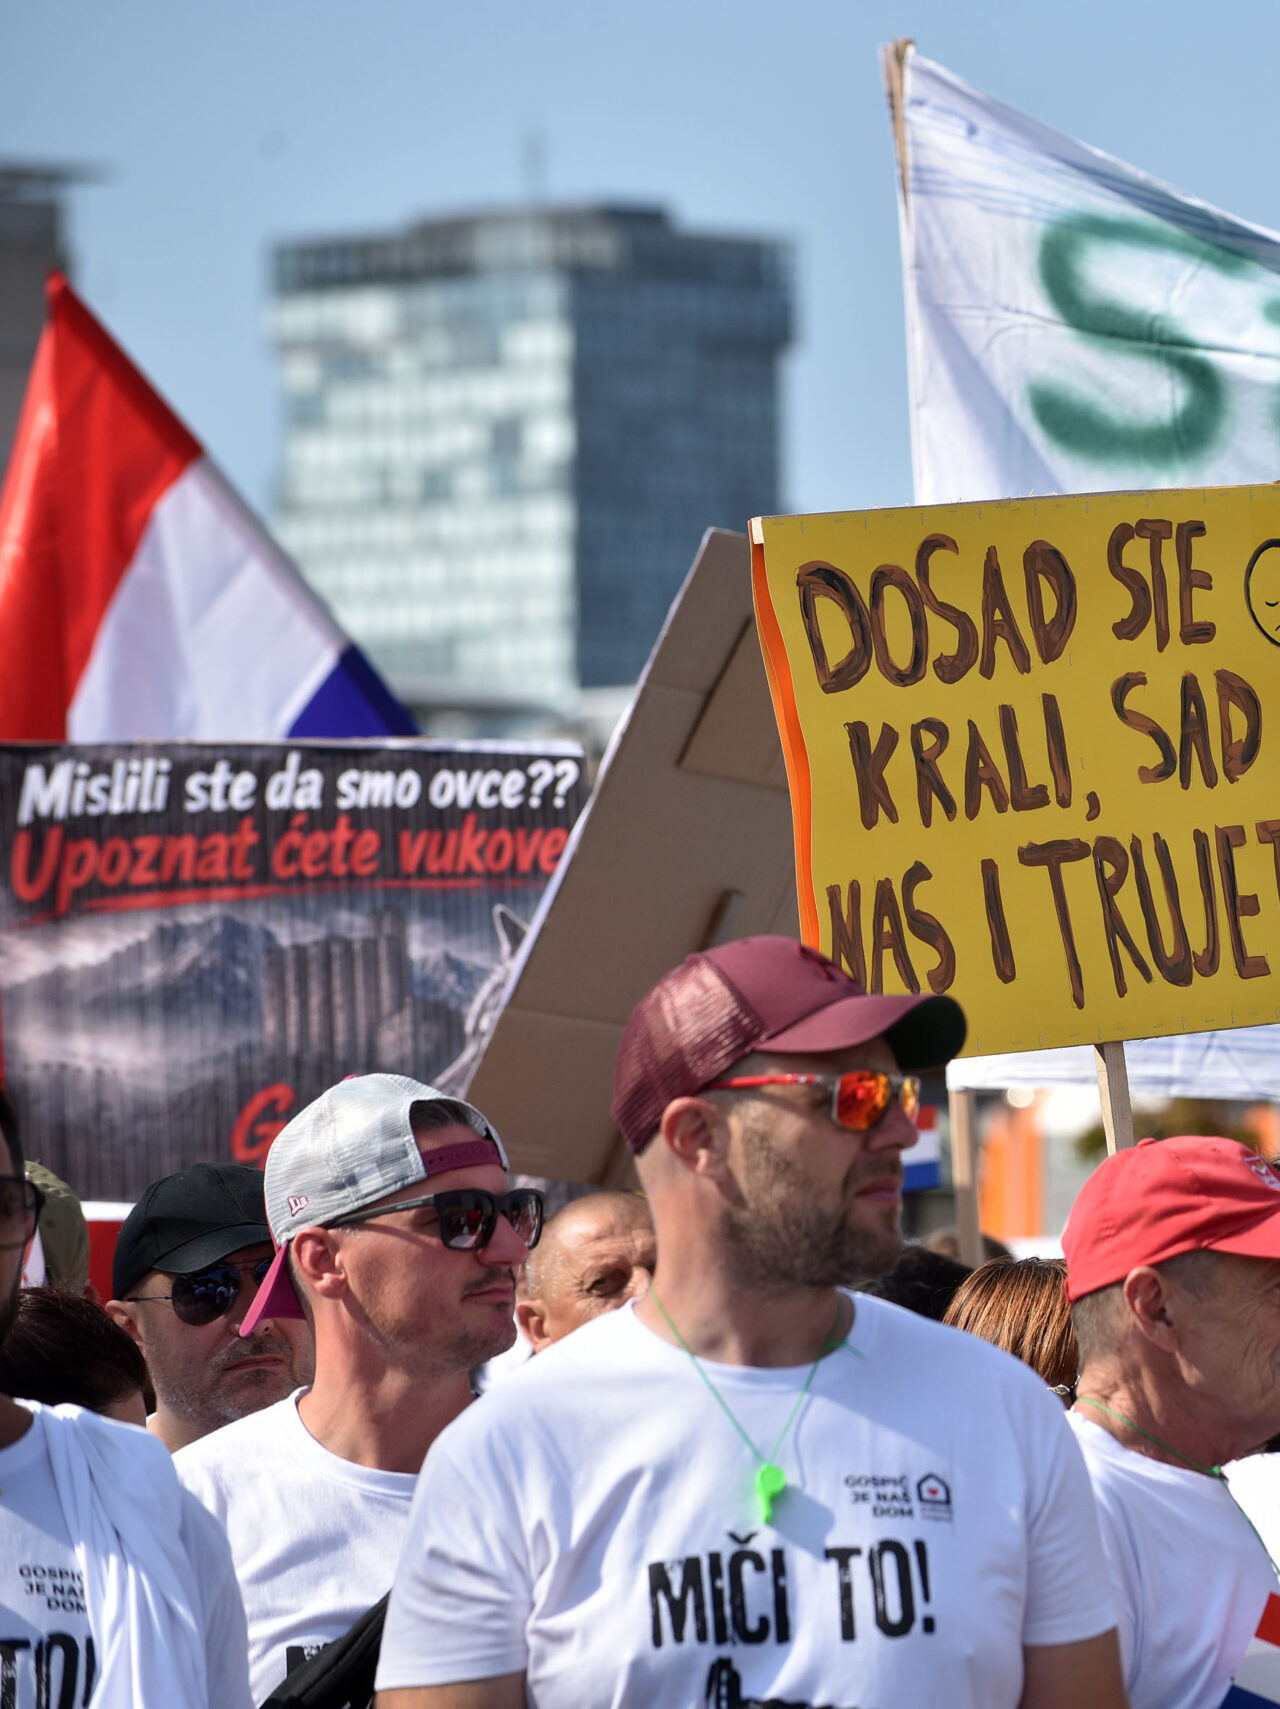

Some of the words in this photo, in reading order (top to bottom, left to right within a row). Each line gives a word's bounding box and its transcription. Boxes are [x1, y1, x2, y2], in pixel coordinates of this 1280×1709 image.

[796, 533, 1078, 694] DOSAD
[1107, 518, 1217, 653] STE
[18, 757, 172, 825] Mislili
[185, 761, 258, 813] ste
[265, 752, 323, 810] da
[336, 770, 421, 810] smo
[428, 758, 580, 809] ovce??
[843, 693, 1100, 830] KRALI,
[1110, 669, 1263, 790] SAD
[10, 814, 259, 917] Upoznat
[272, 813, 382, 878] ćete
[400, 812, 570, 876] vukove
[826, 860, 956, 995] NAS
[980, 858, 1016, 984] I
[852, 1491, 870, 1504] JE
[872, 1504, 914, 1519] DOM
[25, 1583, 46, 1595] JE
[648, 1531, 791, 1649] MIČI
[825, 1539, 936, 1643] TO!
